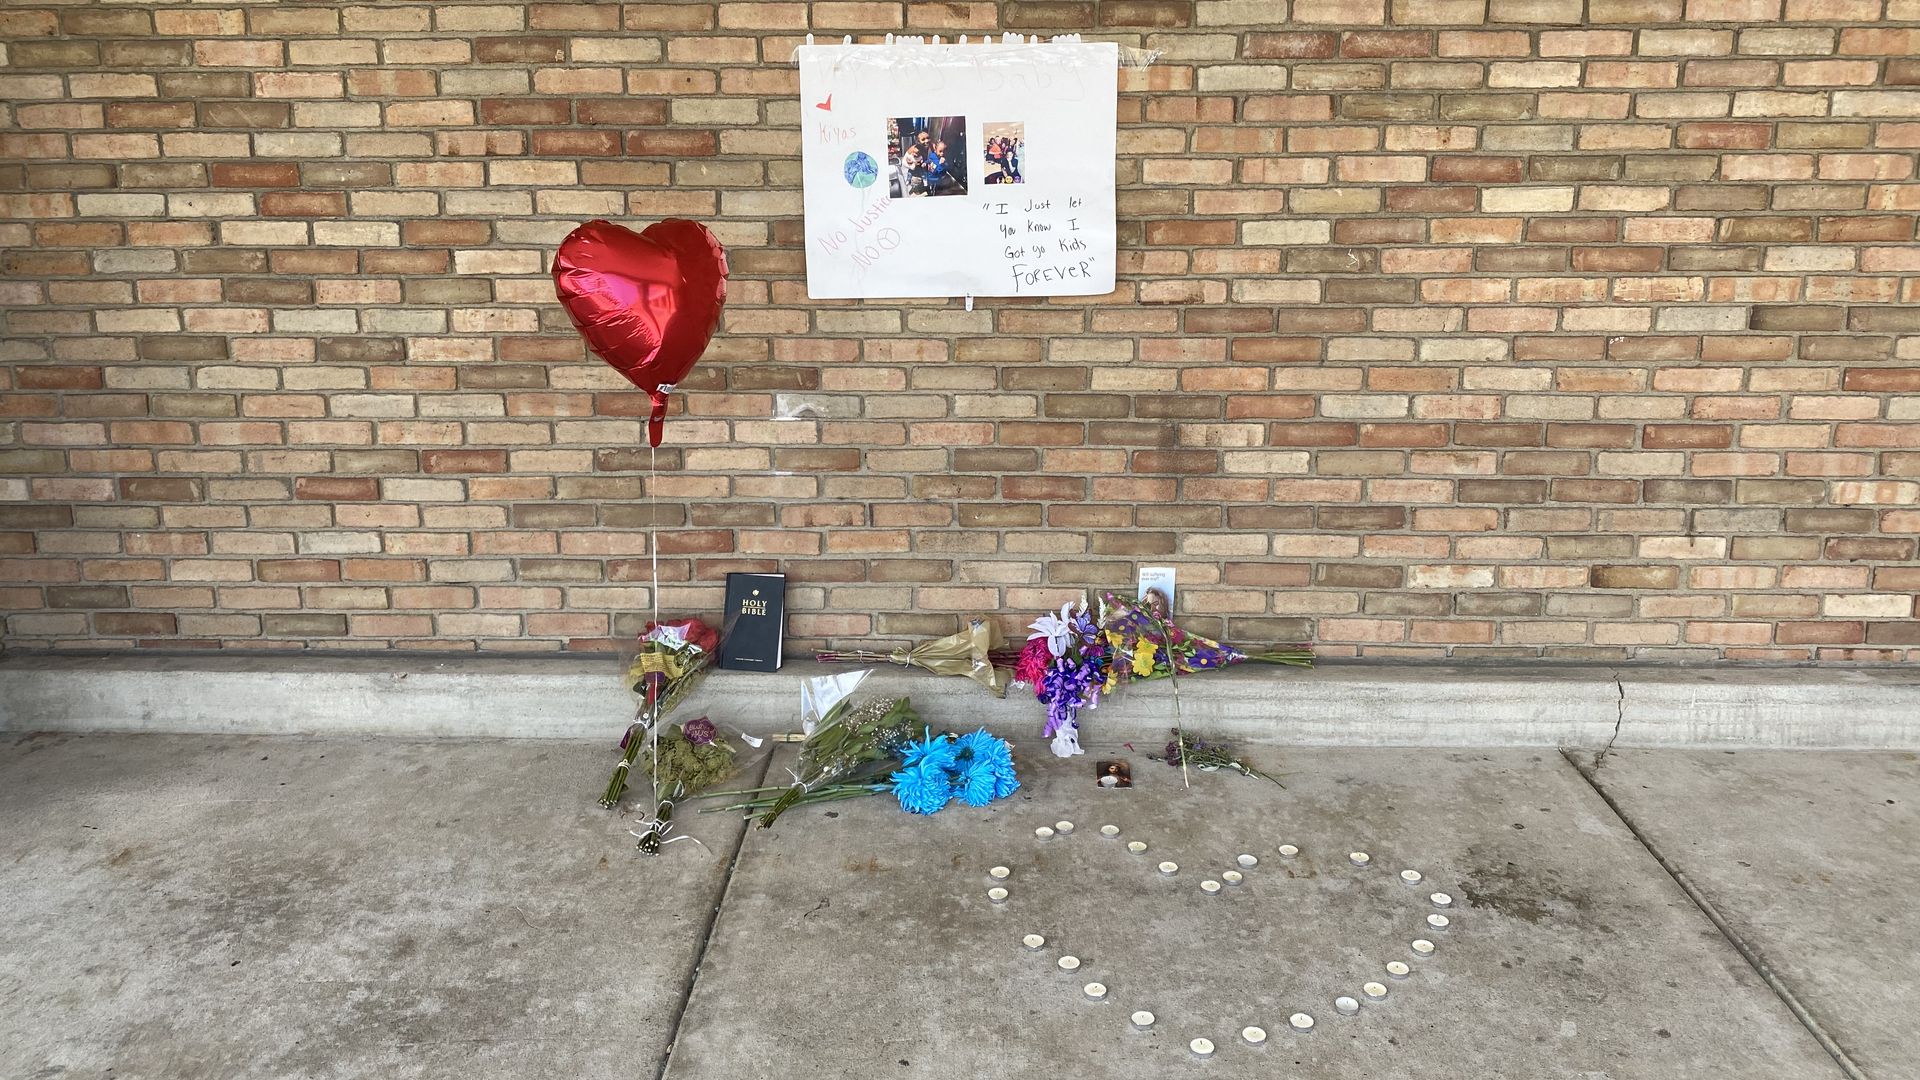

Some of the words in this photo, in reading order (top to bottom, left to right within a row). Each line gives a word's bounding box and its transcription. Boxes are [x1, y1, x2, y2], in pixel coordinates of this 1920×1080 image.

[1068, 196, 1082, 208] let
[1067, 217, 1080, 231] I
[742, 599, 768, 607] HOLY
[741, 607, 767, 616] BIBLE
